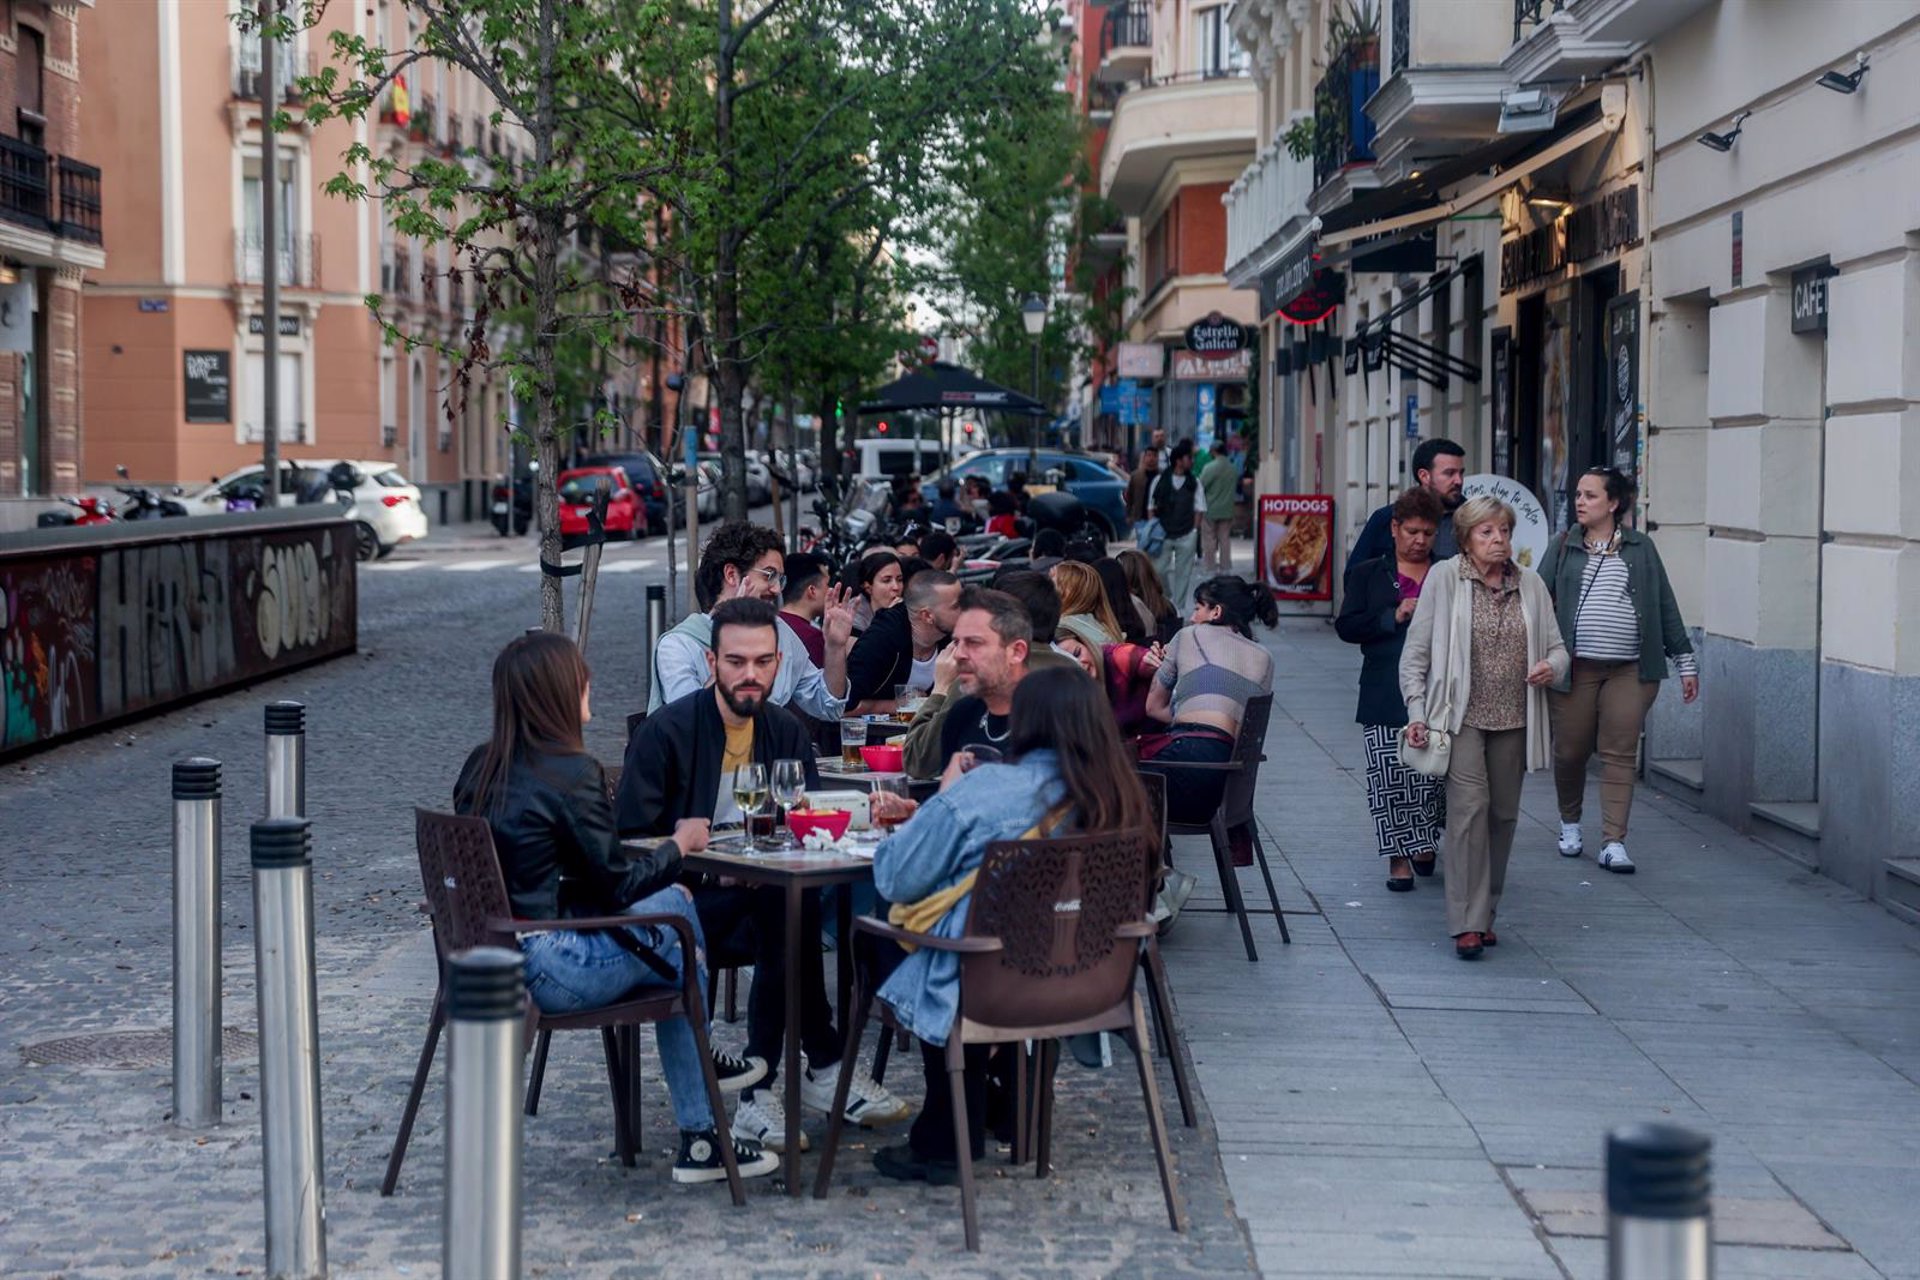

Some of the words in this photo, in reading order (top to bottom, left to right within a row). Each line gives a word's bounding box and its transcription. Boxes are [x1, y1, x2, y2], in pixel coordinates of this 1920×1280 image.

[1193, 325, 1239, 338] Estrella
[1195, 337, 1237, 351] Galicia
[1264, 499, 1329, 512] HOTDOGS
